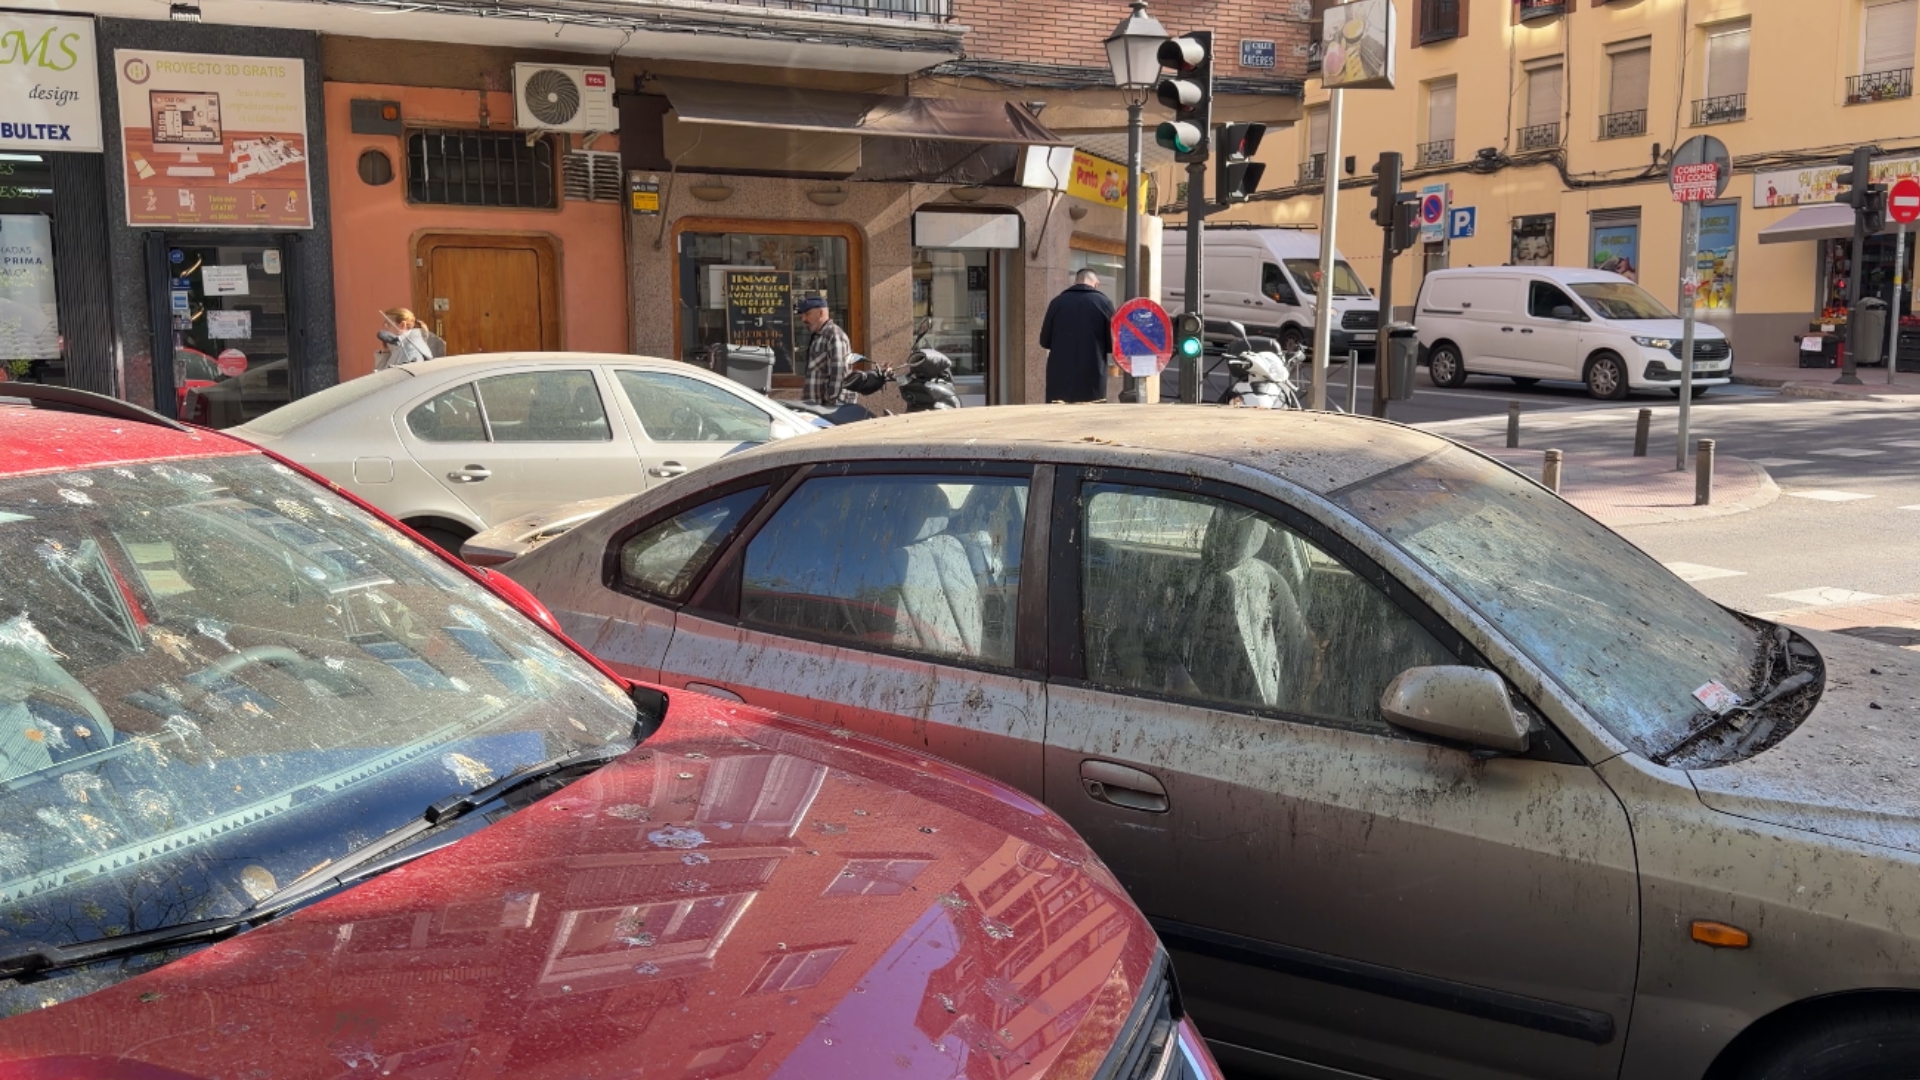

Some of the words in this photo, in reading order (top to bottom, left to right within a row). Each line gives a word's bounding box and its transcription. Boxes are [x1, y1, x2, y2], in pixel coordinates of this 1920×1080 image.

[156, 60, 222, 76] PROYECTO
[224, 65, 240, 76] 3D
[243, 65, 286, 79] GRATIS
[29, 83, 80, 107] design
[0, 122, 71, 141] BULTEX
[1077, 166, 1099, 188] Punto
[1675, 175, 1685, 183] TU
[1687, 172, 1716, 182] COCHE
[1677, 164, 1715, 174] COMPRO
[1673, 189, 1687, 200] 671
[1702, 187, 1716, 199] 752
[1453, 210, 1471, 236] P
[4, 256, 43, 266] PRIMA
